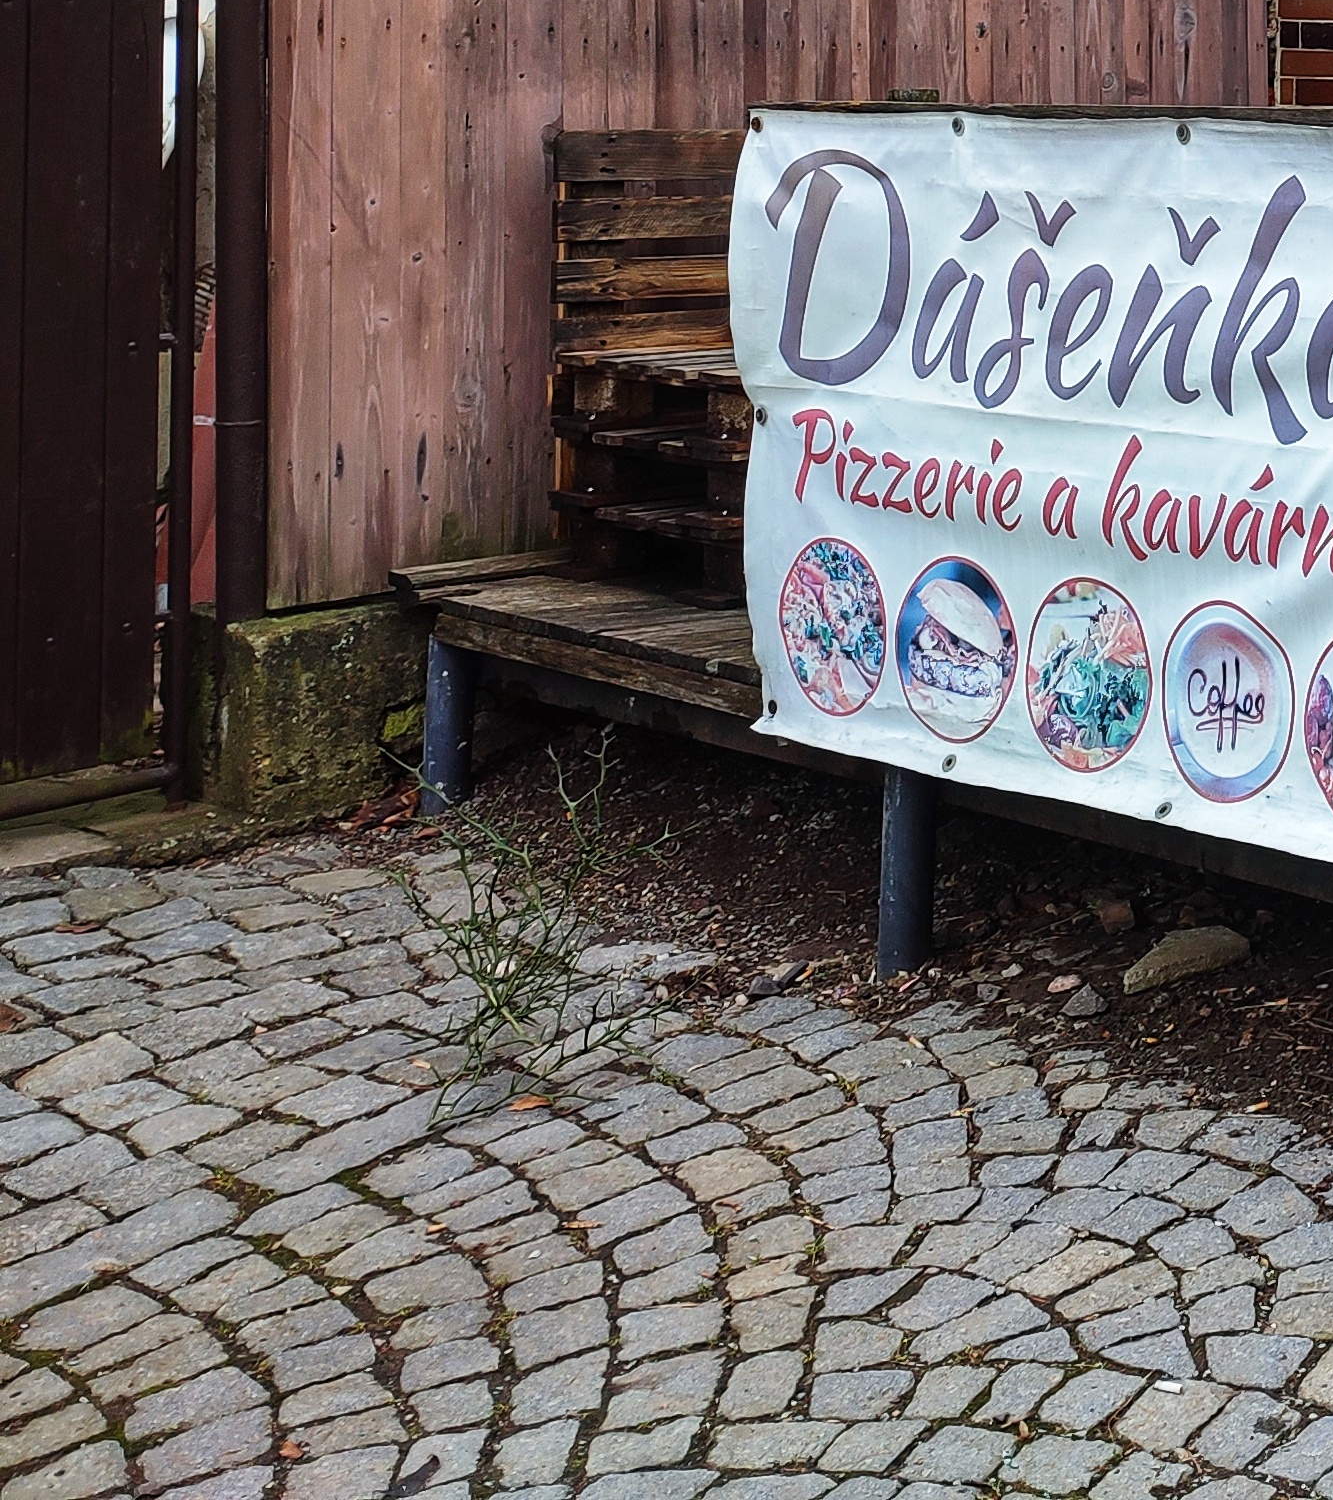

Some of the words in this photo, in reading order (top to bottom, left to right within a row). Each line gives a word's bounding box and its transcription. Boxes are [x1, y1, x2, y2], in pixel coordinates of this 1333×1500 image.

[792, 409, 1022, 531] Pizzerie
[1043, 477, 1079, 539] a
[1186, 657, 1265, 753] Coffee
